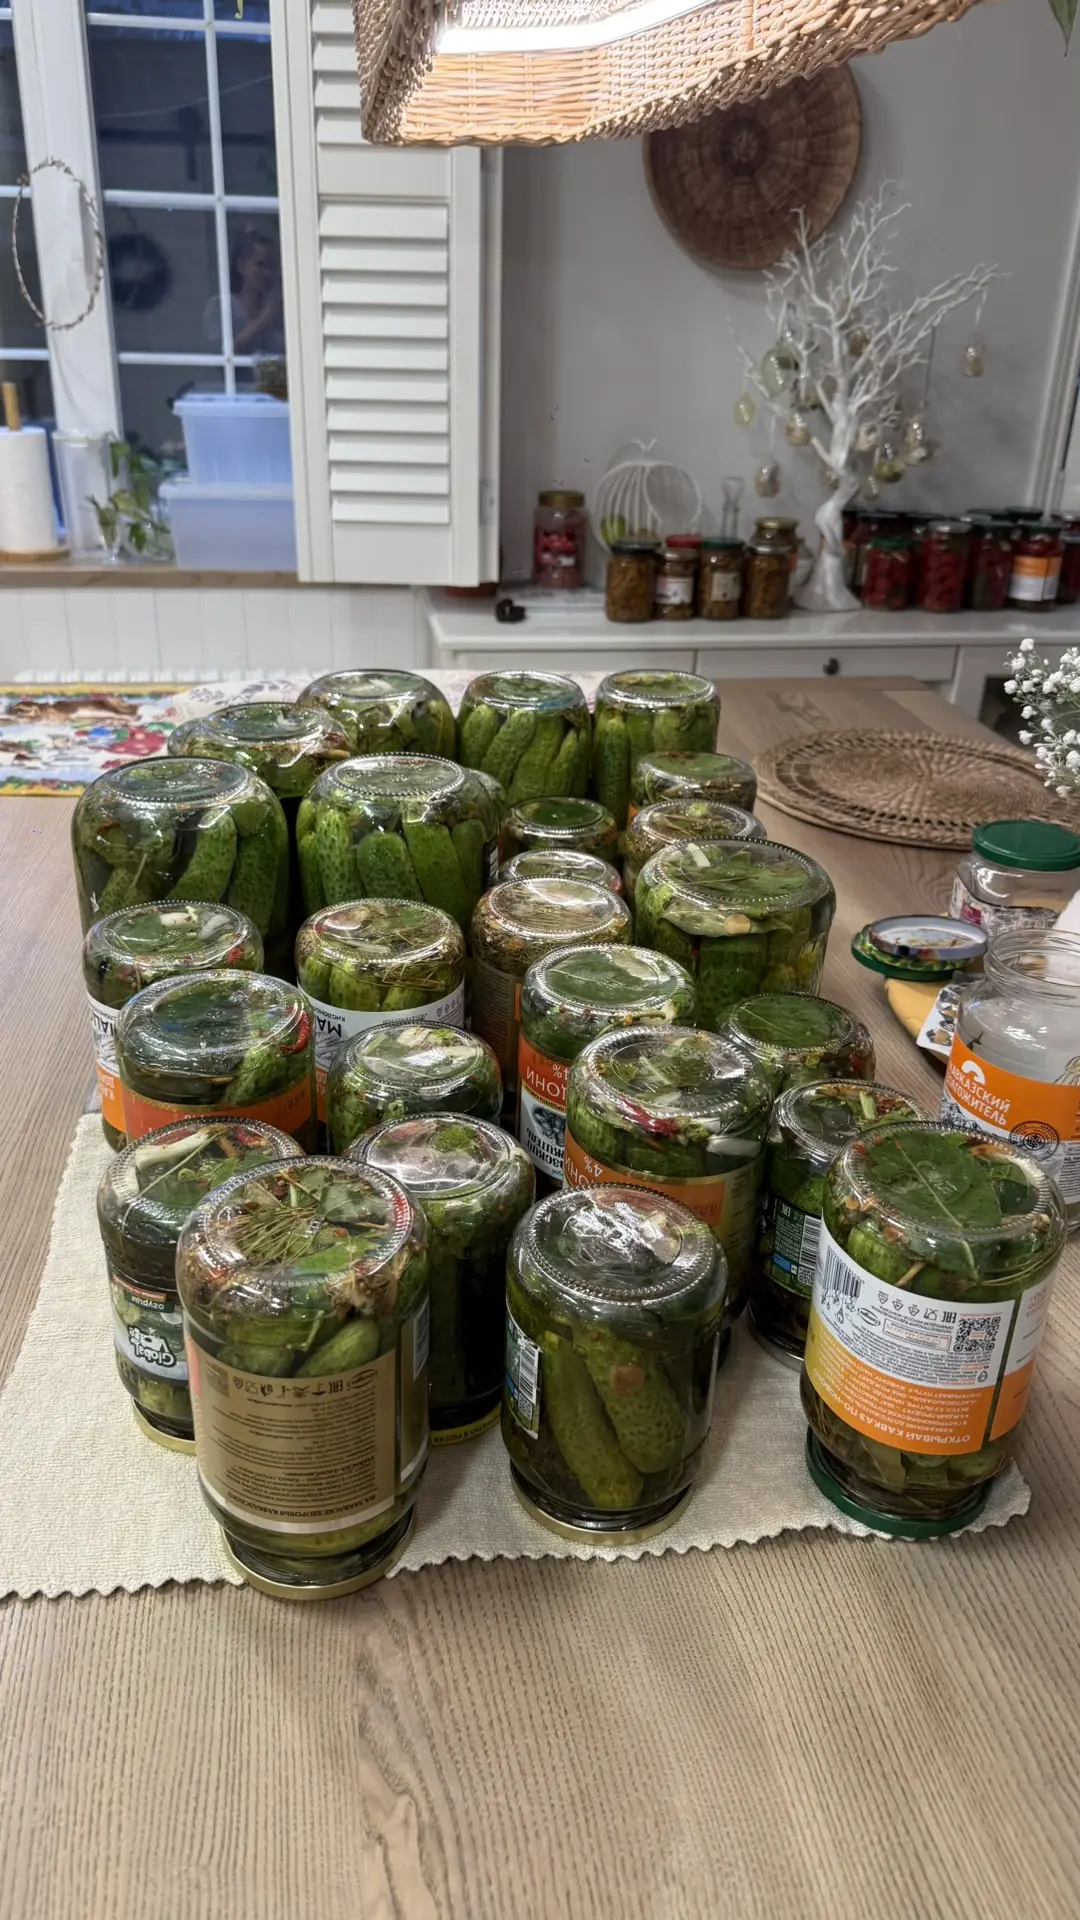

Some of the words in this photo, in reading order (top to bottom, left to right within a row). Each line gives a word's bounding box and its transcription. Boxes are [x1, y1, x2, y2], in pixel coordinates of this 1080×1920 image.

[584, 1155, 603, 1177] 4%
[134, 1343, 175, 1367] Global
[859, 1412, 904, 1437] КАВКАЗ
[905, 1432, 970, 1444] ОТКРЫВАЙ
